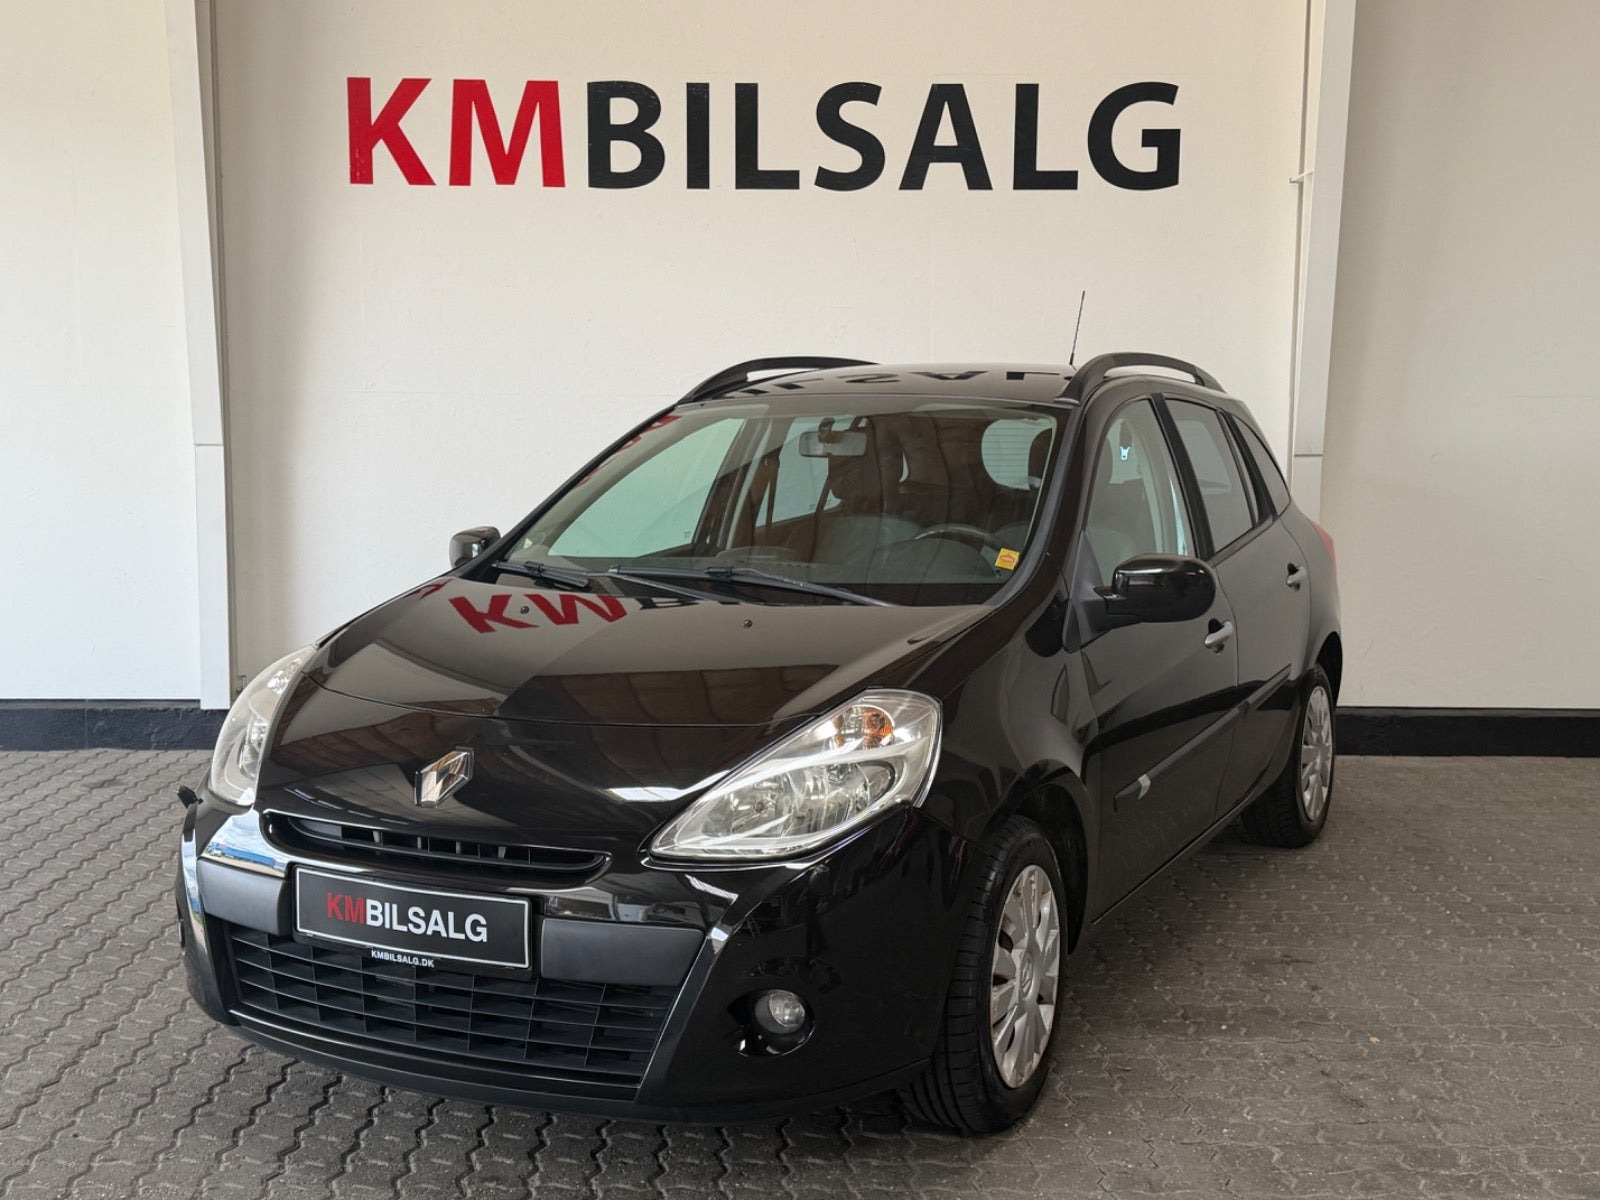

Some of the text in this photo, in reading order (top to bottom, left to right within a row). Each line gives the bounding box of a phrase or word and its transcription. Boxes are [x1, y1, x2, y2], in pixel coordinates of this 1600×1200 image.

[347, 77, 1182, 191] KMBILSALG
[327, 892, 488, 943] KMBILSALG
[371, 949, 435, 968] KMBILSALG.DK
